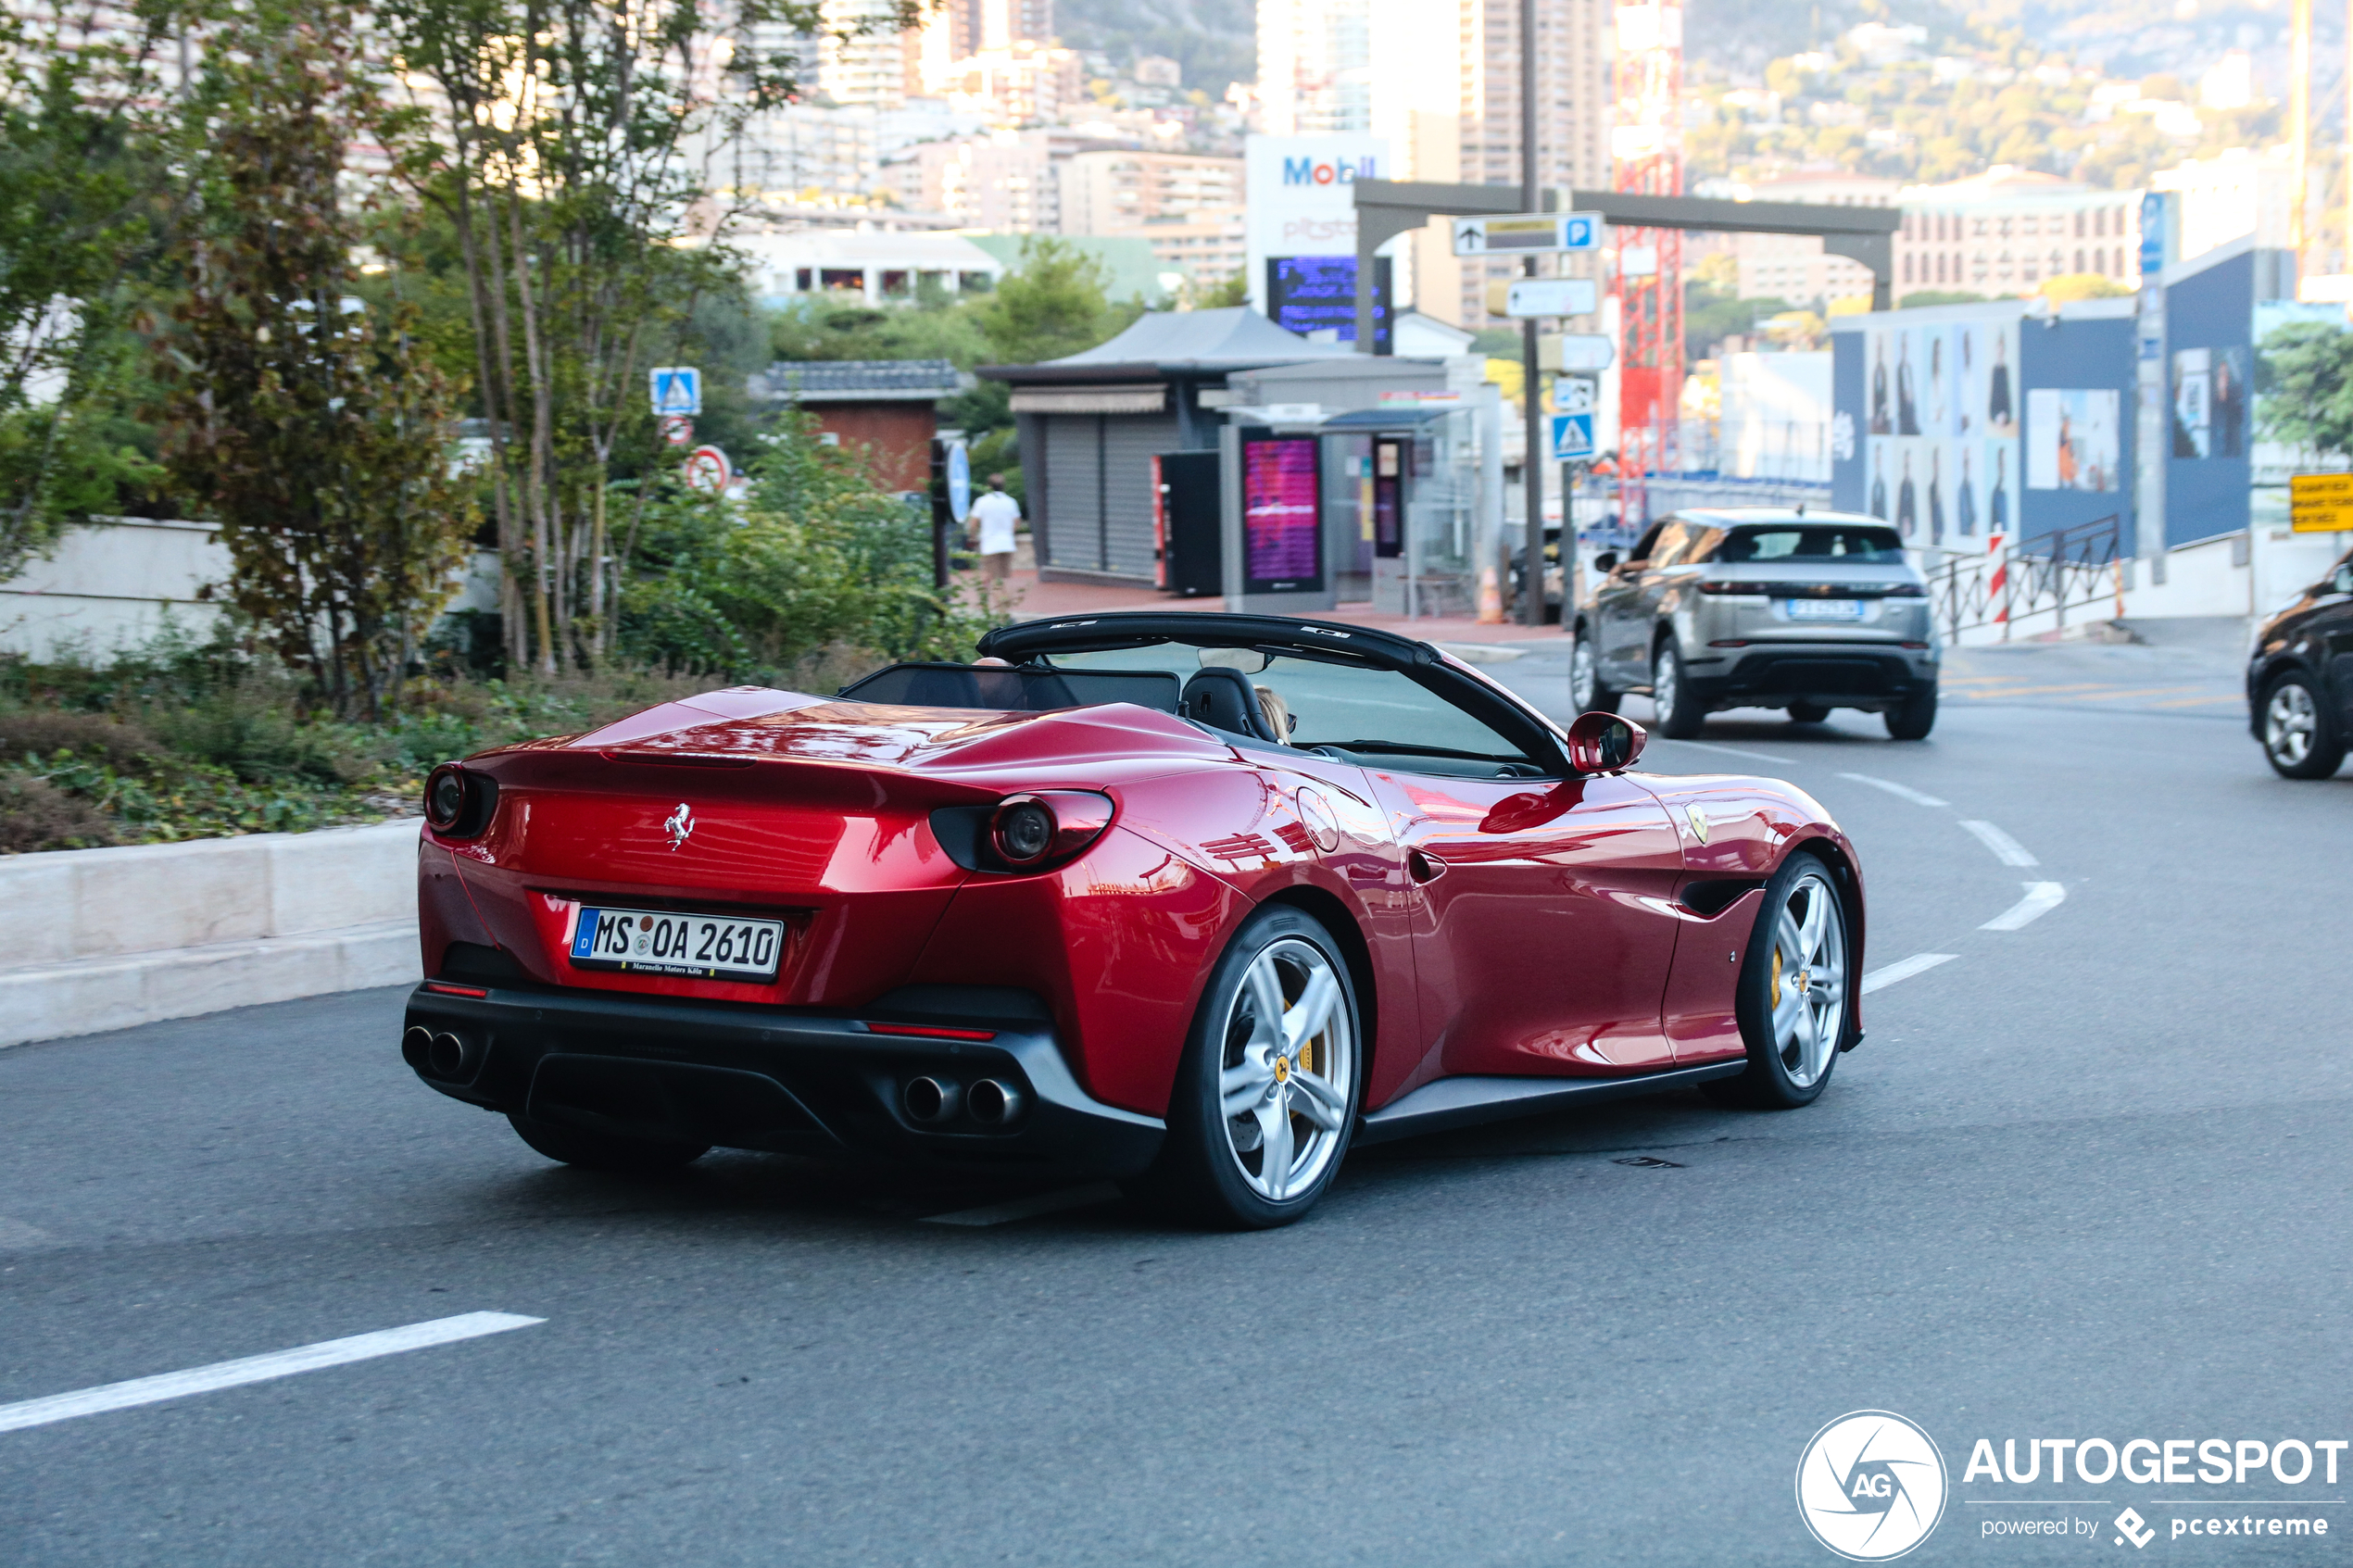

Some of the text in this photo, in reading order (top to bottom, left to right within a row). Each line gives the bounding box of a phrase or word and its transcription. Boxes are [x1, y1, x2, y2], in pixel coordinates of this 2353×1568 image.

[1283, 157, 1375, 185] Mobil
[1570, 222, 1587, 244] P
[580, 937, 588, 949] D
[593, 915, 774, 966] MS OA 2610
[633, 962, 703, 975] Maranello Motors Köln
